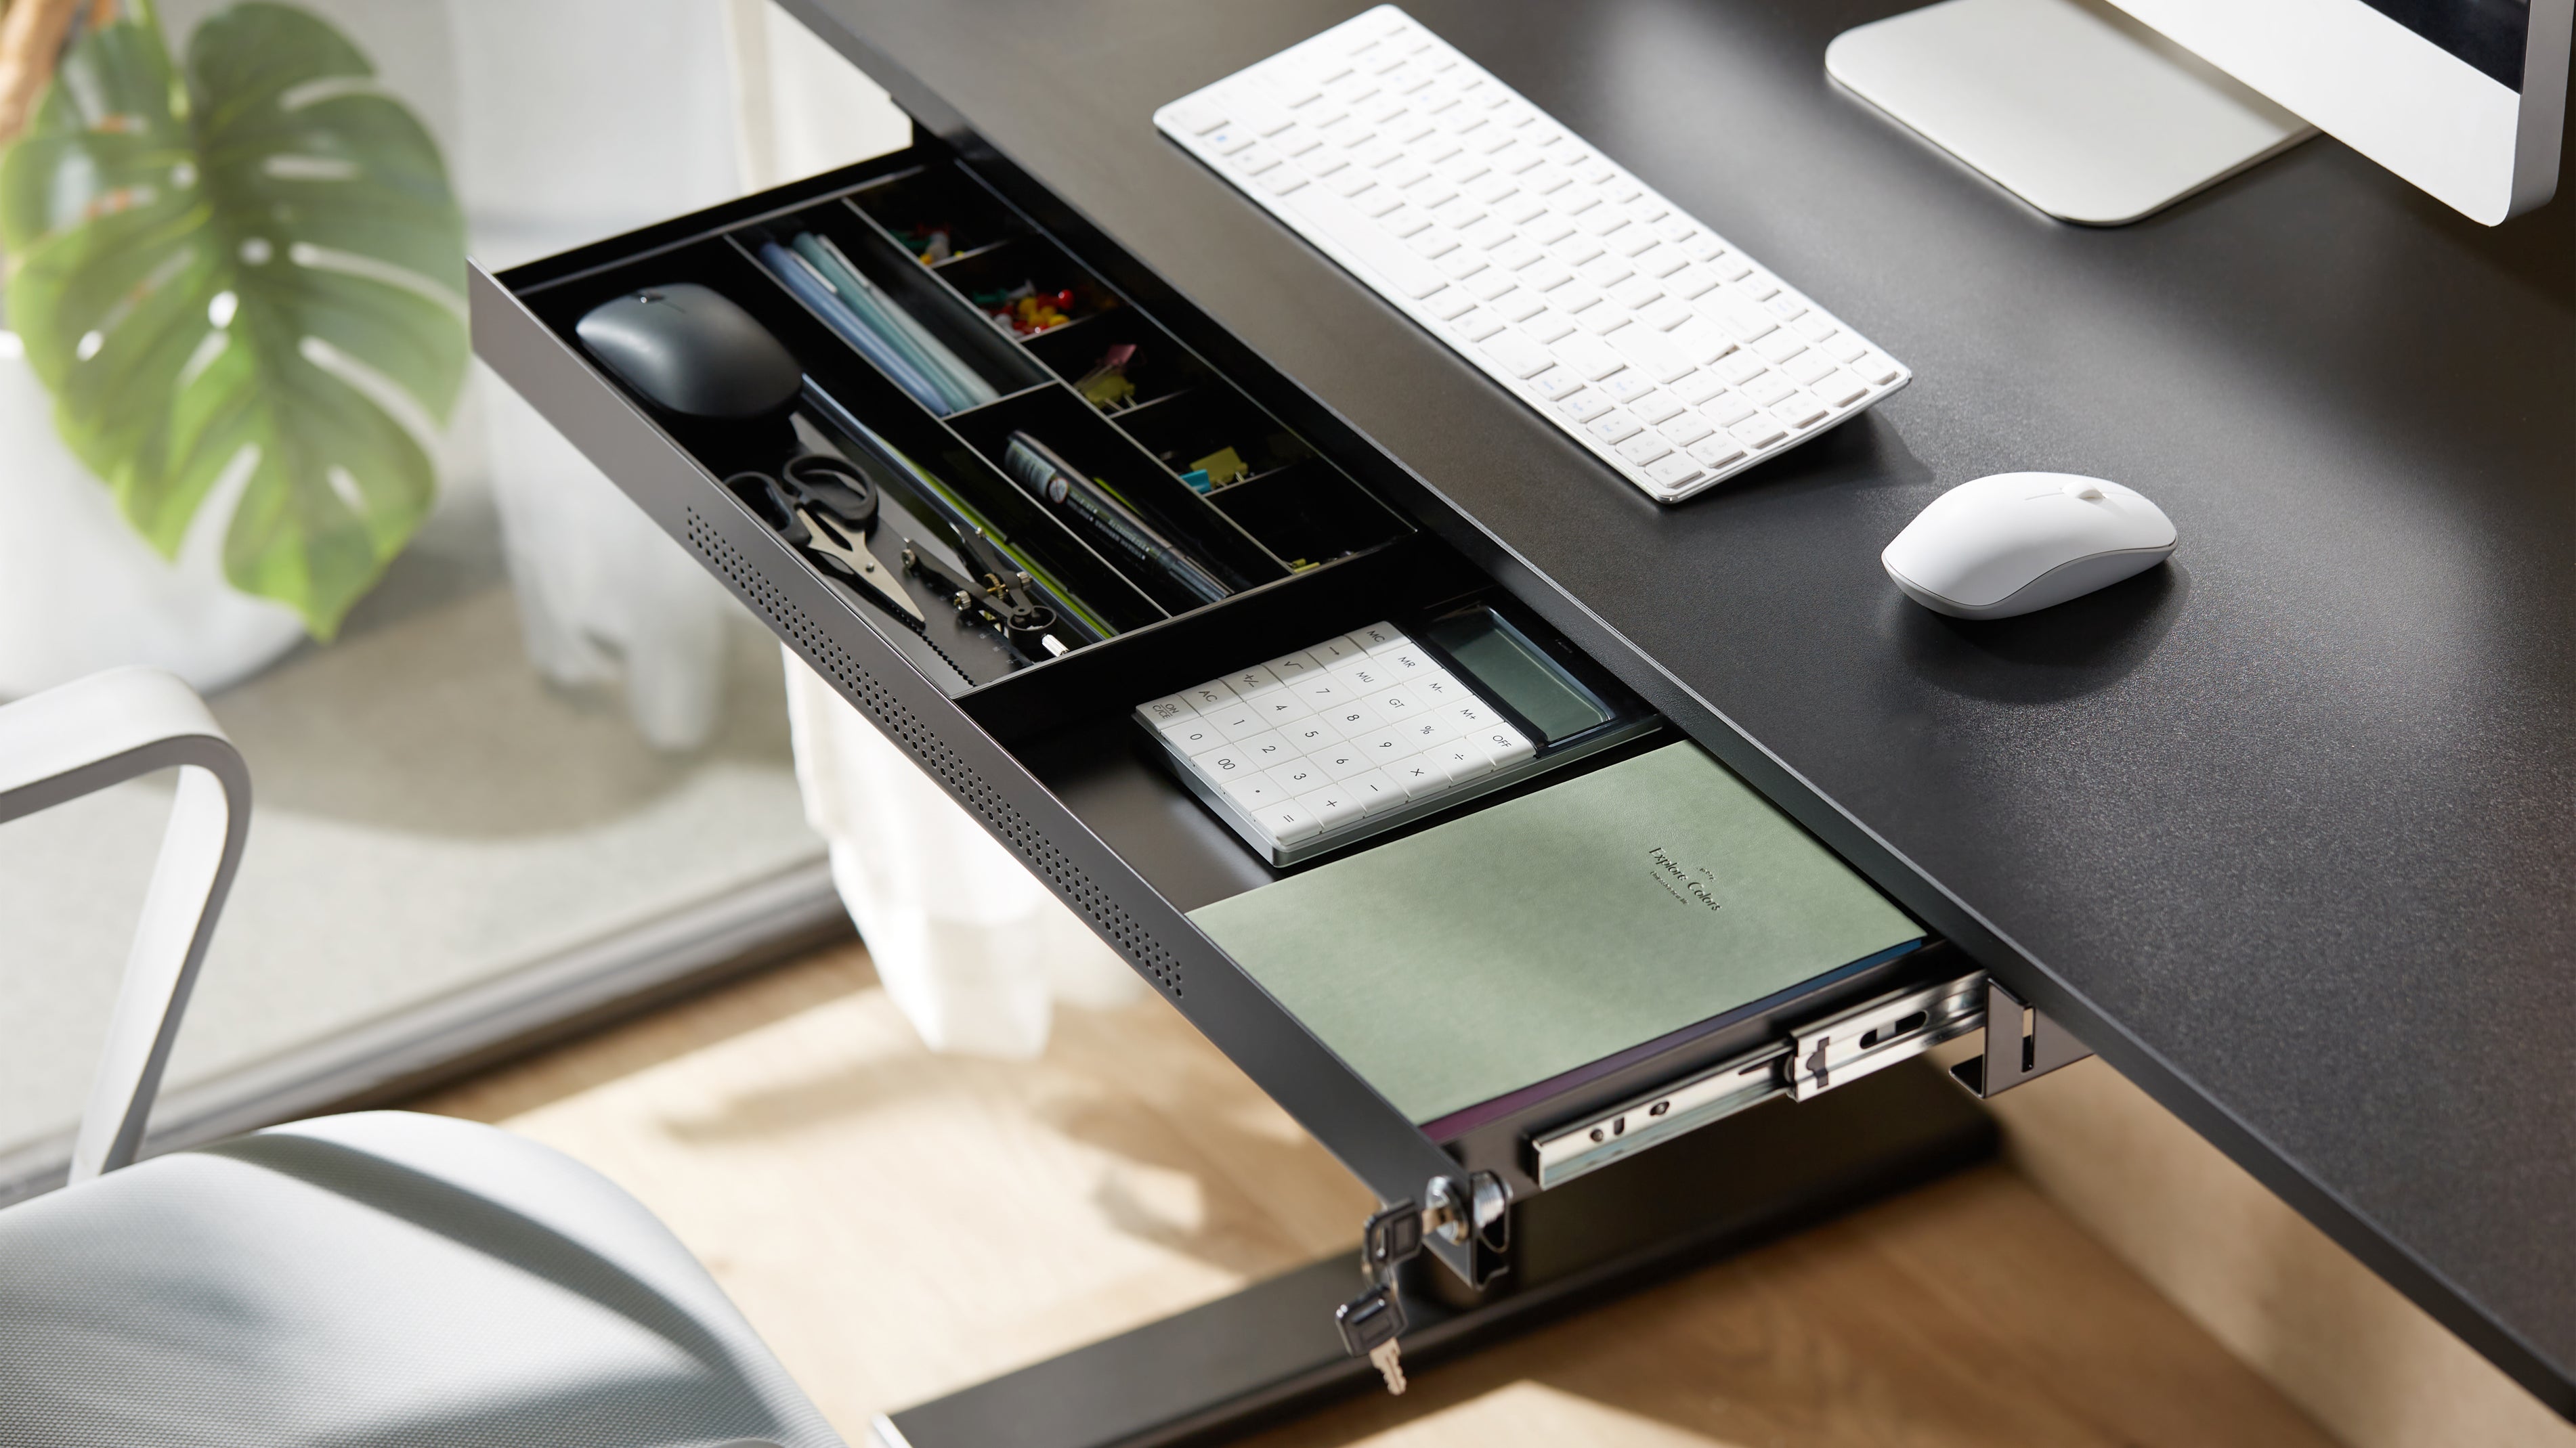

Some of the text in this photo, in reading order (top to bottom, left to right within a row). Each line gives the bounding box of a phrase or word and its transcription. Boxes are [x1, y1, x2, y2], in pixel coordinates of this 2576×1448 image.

[1367, 630, 1386, 642] MC
[1398, 656, 1415, 668] MR
[1356, 672, 1375, 683] MU
[1429, 682, 1443, 693] M-
[1198, 690, 1218, 703] AC
[1165, 703, 1180, 714] ON
[1389, 699, 1405, 708] GT
[1153, 705, 1171, 720] C/CE
[1460, 709, 1476, 720] M+
[1420, 725, 1435, 735] %
[1493, 734, 1512, 747] OFF
[1261, 745, 1276, 753] 2
[1217, 758, 1236, 770] 00
[1293, 772, 1307, 781] 3
[1649, 848, 1687, 881] Explore
[1687, 881, 1721, 911] Colors
